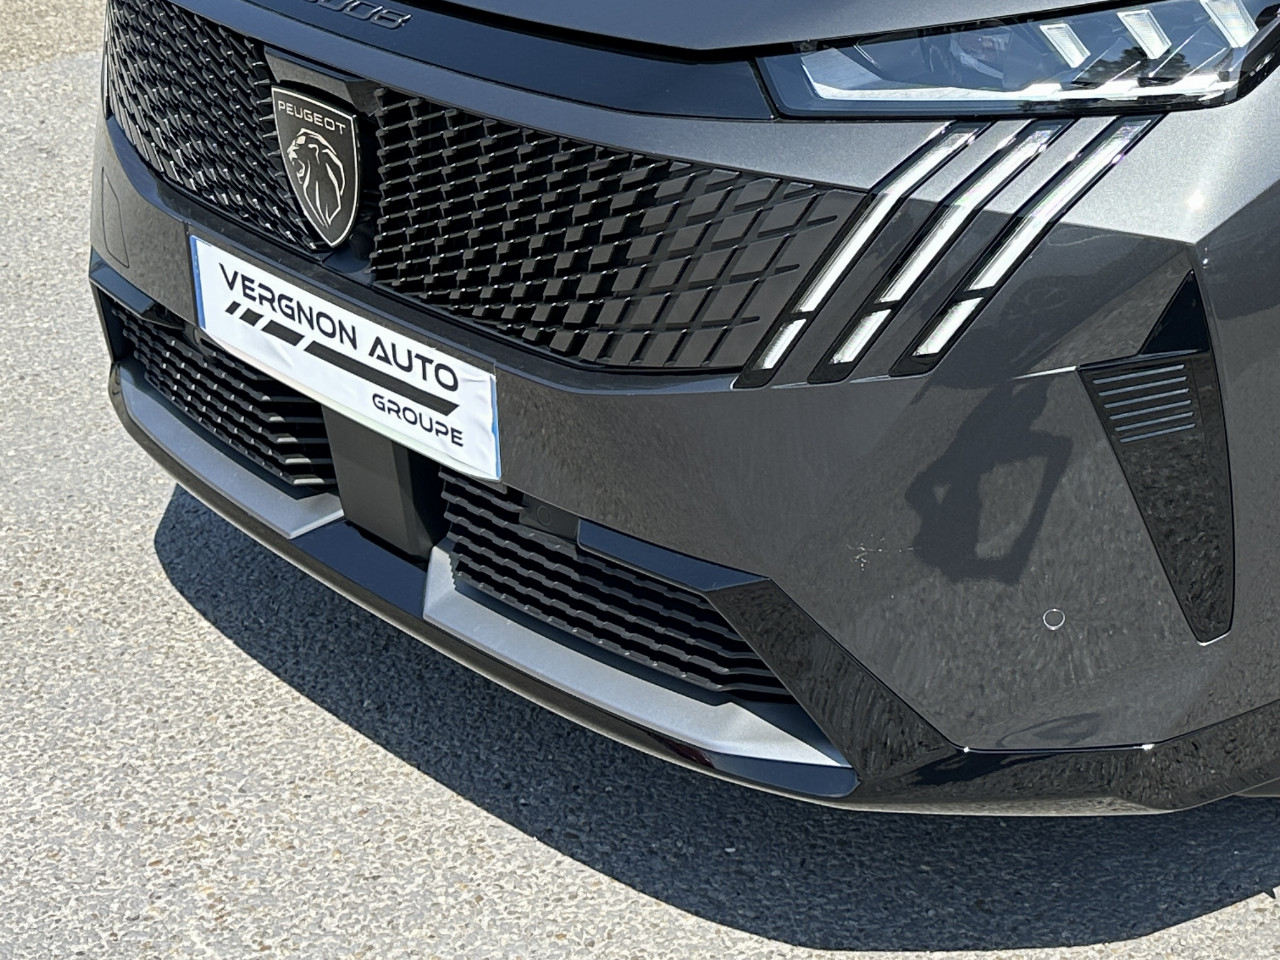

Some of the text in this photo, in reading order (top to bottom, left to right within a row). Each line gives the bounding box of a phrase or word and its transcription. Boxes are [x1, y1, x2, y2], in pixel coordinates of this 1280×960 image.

[278, 100, 346, 135] PEUGEOT
[218, 261, 460, 393] VERGNON AUTO
[371, 391, 465, 447] GROUPE
